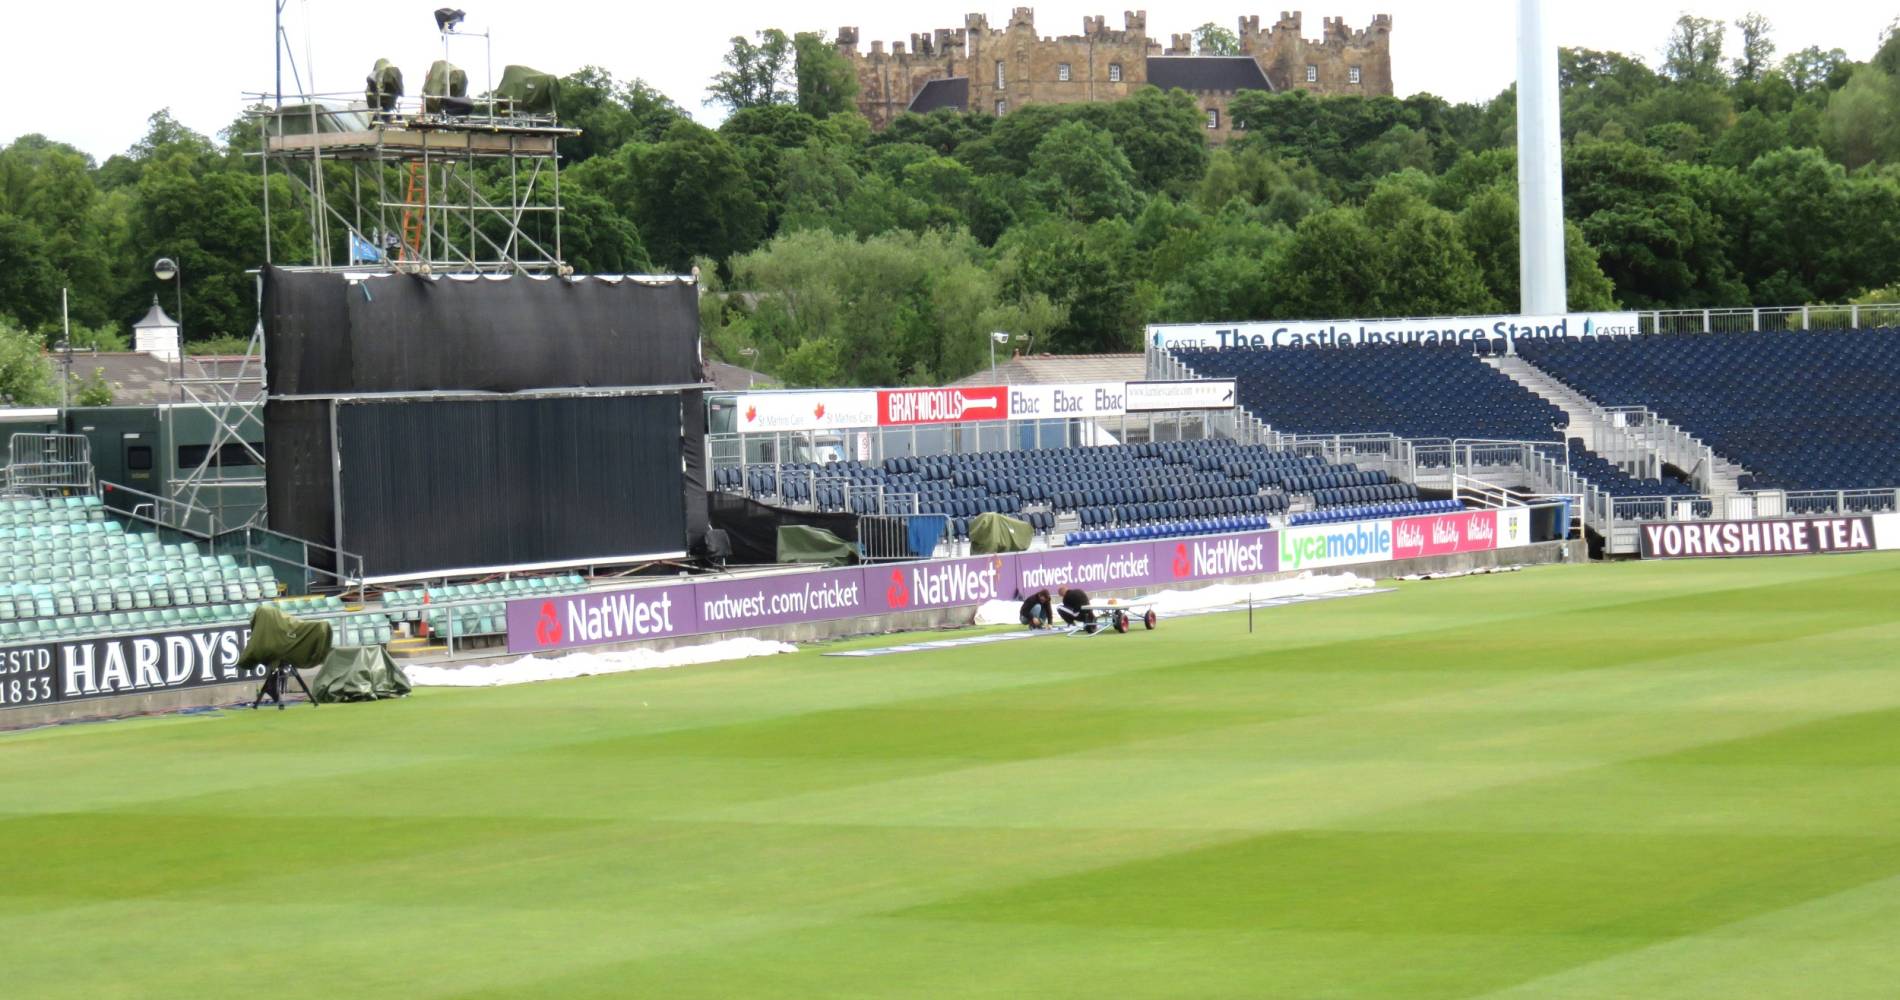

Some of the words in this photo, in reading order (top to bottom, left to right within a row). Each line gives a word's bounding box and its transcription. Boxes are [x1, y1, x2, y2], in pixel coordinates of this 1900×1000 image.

[1165, 339, 1207, 350] CASTLE
[1216, 328, 1265, 350] The
[1272, 326, 1352, 348] Castle
[1360, 327, 1486, 344] Insurance
[1493, 318, 1567, 343] Stand
[1595, 326, 1635, 336] CASTLE
[889, 390, 962, 422] GRAY-NICOLLS
[1011, 391, 1040, 414] Ebac
[1053, 390, 1083, 412] Ebac
[1095, 388, 1123, 411] Ebac
[1280, 523, 1390, 568] Lycamobile
[1397, 520, 1424, 554] Vitality
[1433, 517, 1459, 551] Vitality
[1468, 513, 1493, 547] Vitality
[1647, 520, 1809, 555] YORKSHIRE
[1812, 518, 1869, 549] TEA
[1023, 552, 1149, 588] natwest.com/cricket
[1193, 537, 1263, 576] NatWest
[913, 560, 997, 606] NatWest
[567, 592, 673, 642] NatWest
[704, 580, 859, 621] natwest.com/cricket
[0, 648, 50, 674] ESTD
[63, 629, 240, 697] HARDYS
[0, 677, 51, 703] 1853
